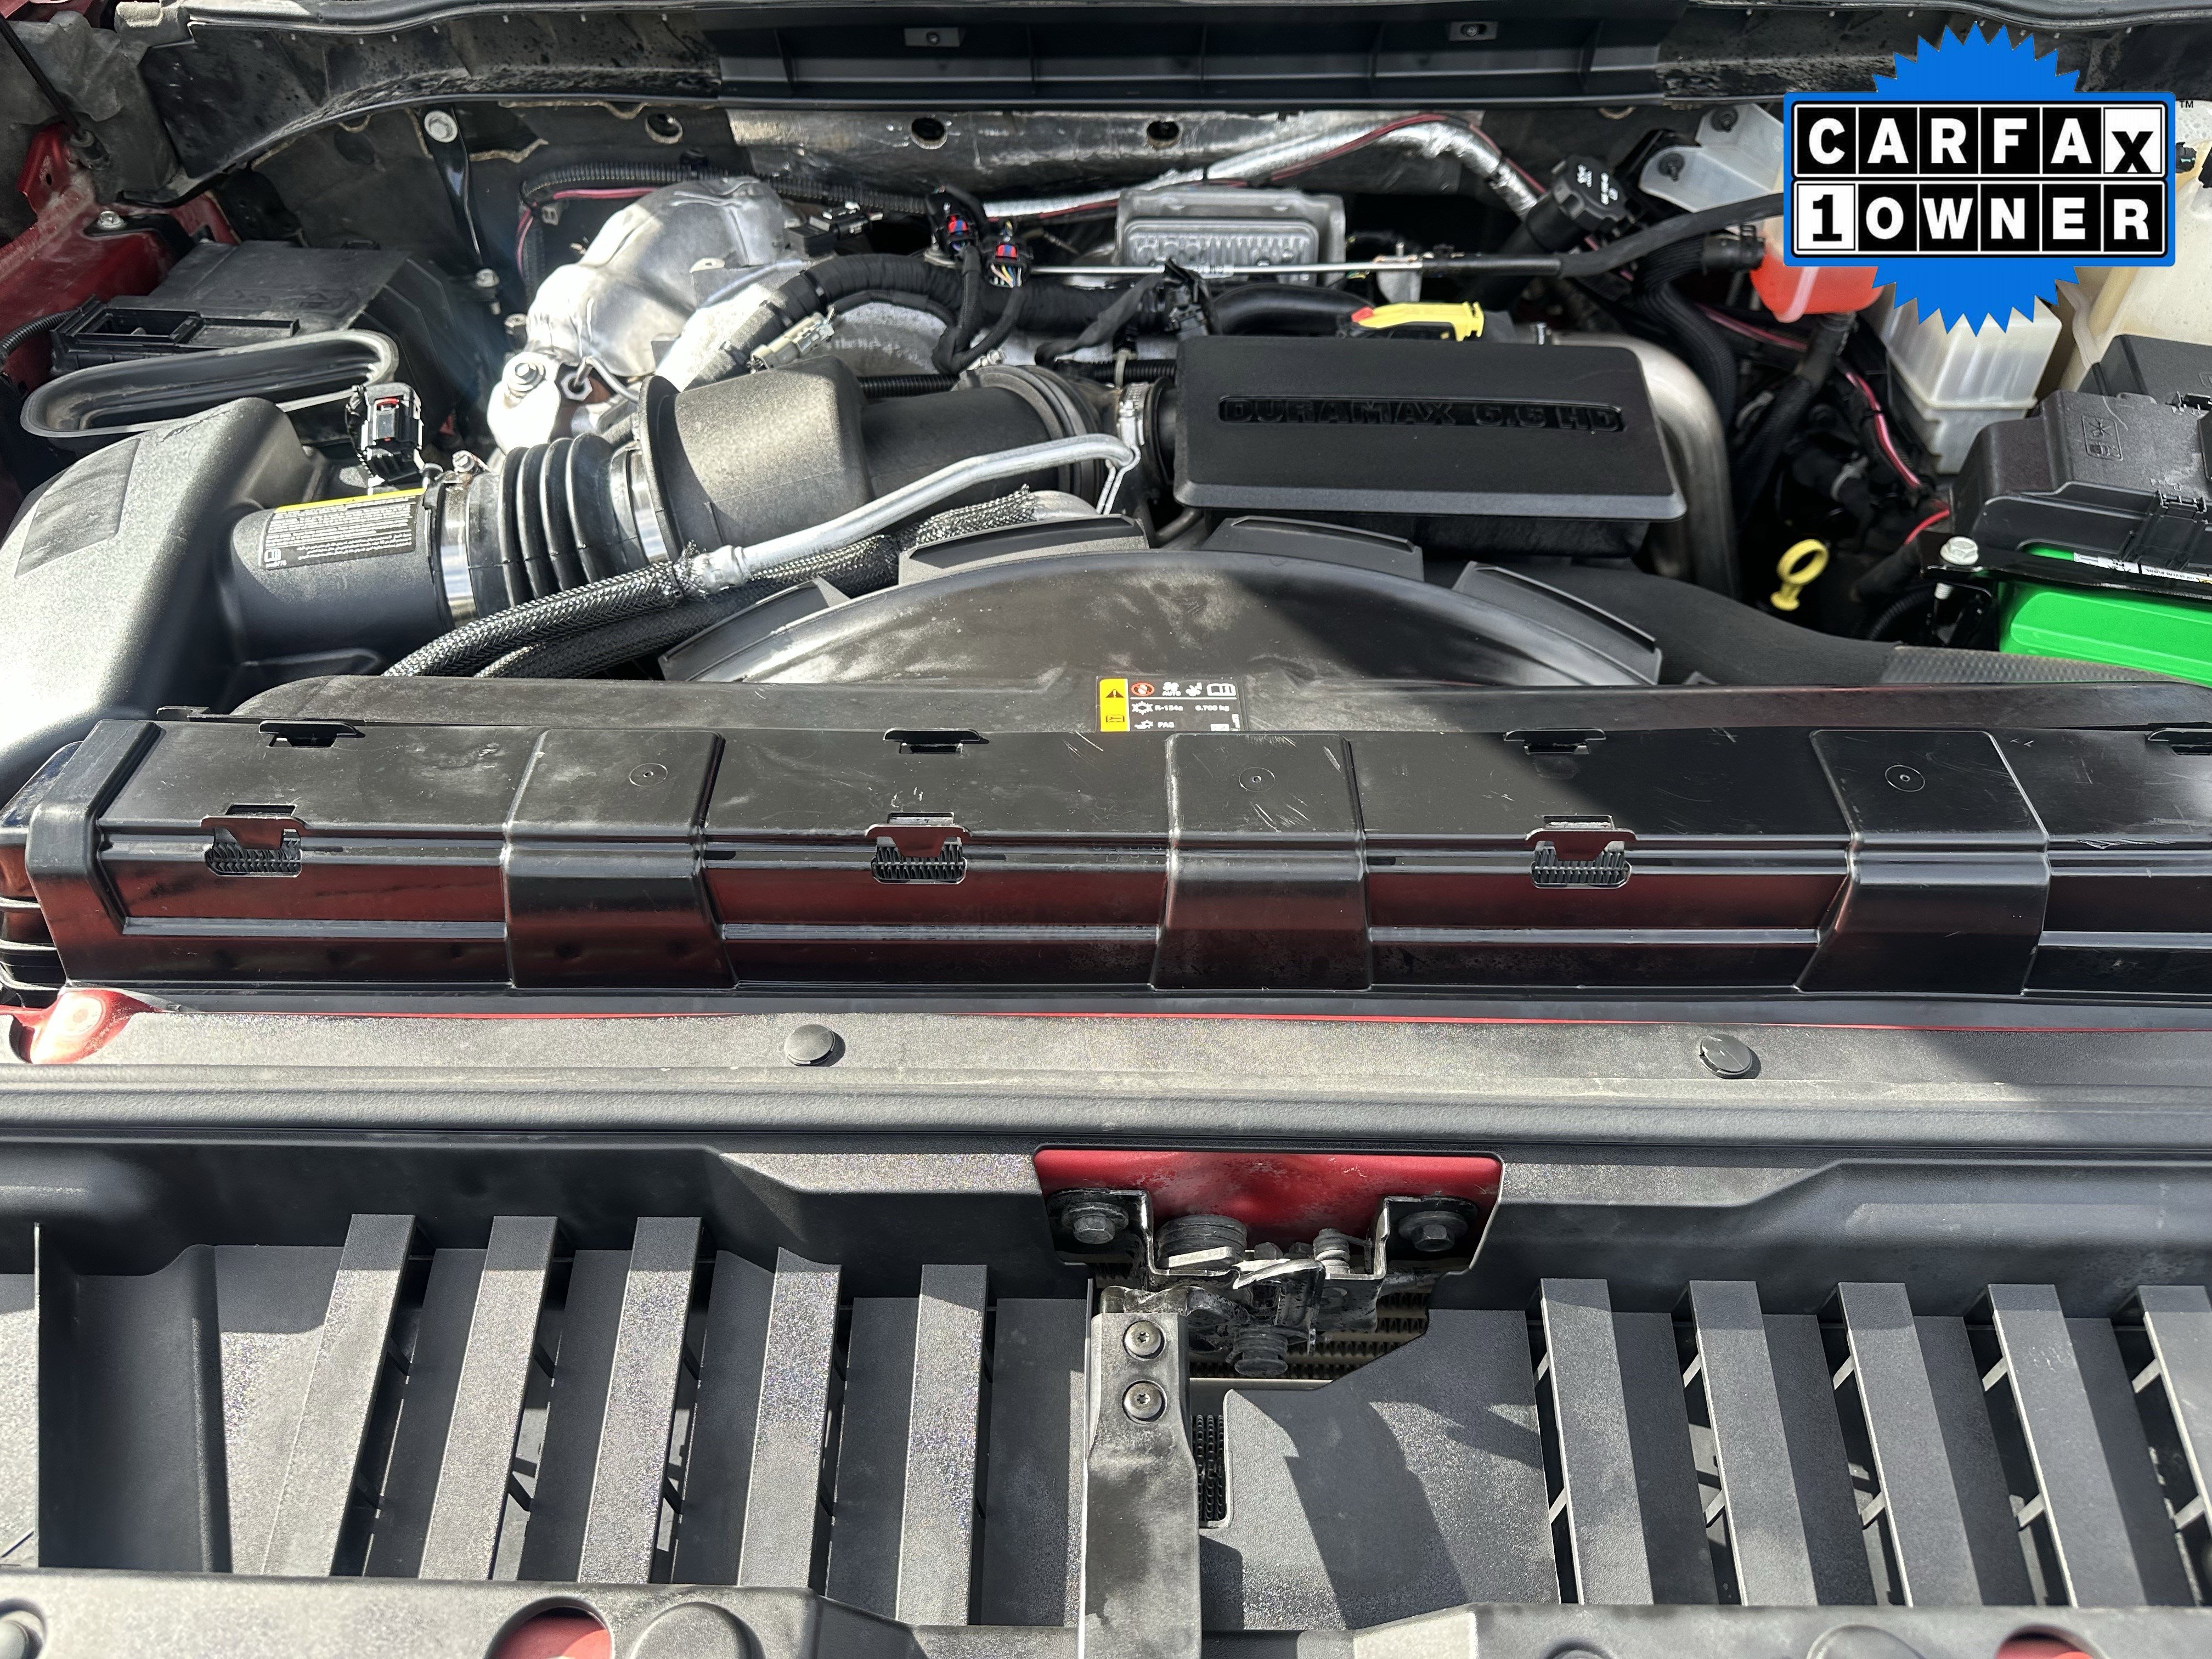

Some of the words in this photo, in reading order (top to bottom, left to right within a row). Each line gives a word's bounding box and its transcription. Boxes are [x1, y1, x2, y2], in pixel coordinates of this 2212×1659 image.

[1224, 400, 1456, 425] DURAMAX
[1473, 404, 1547, 428] 6.6
[1555, 405, 1619, 432] HD
